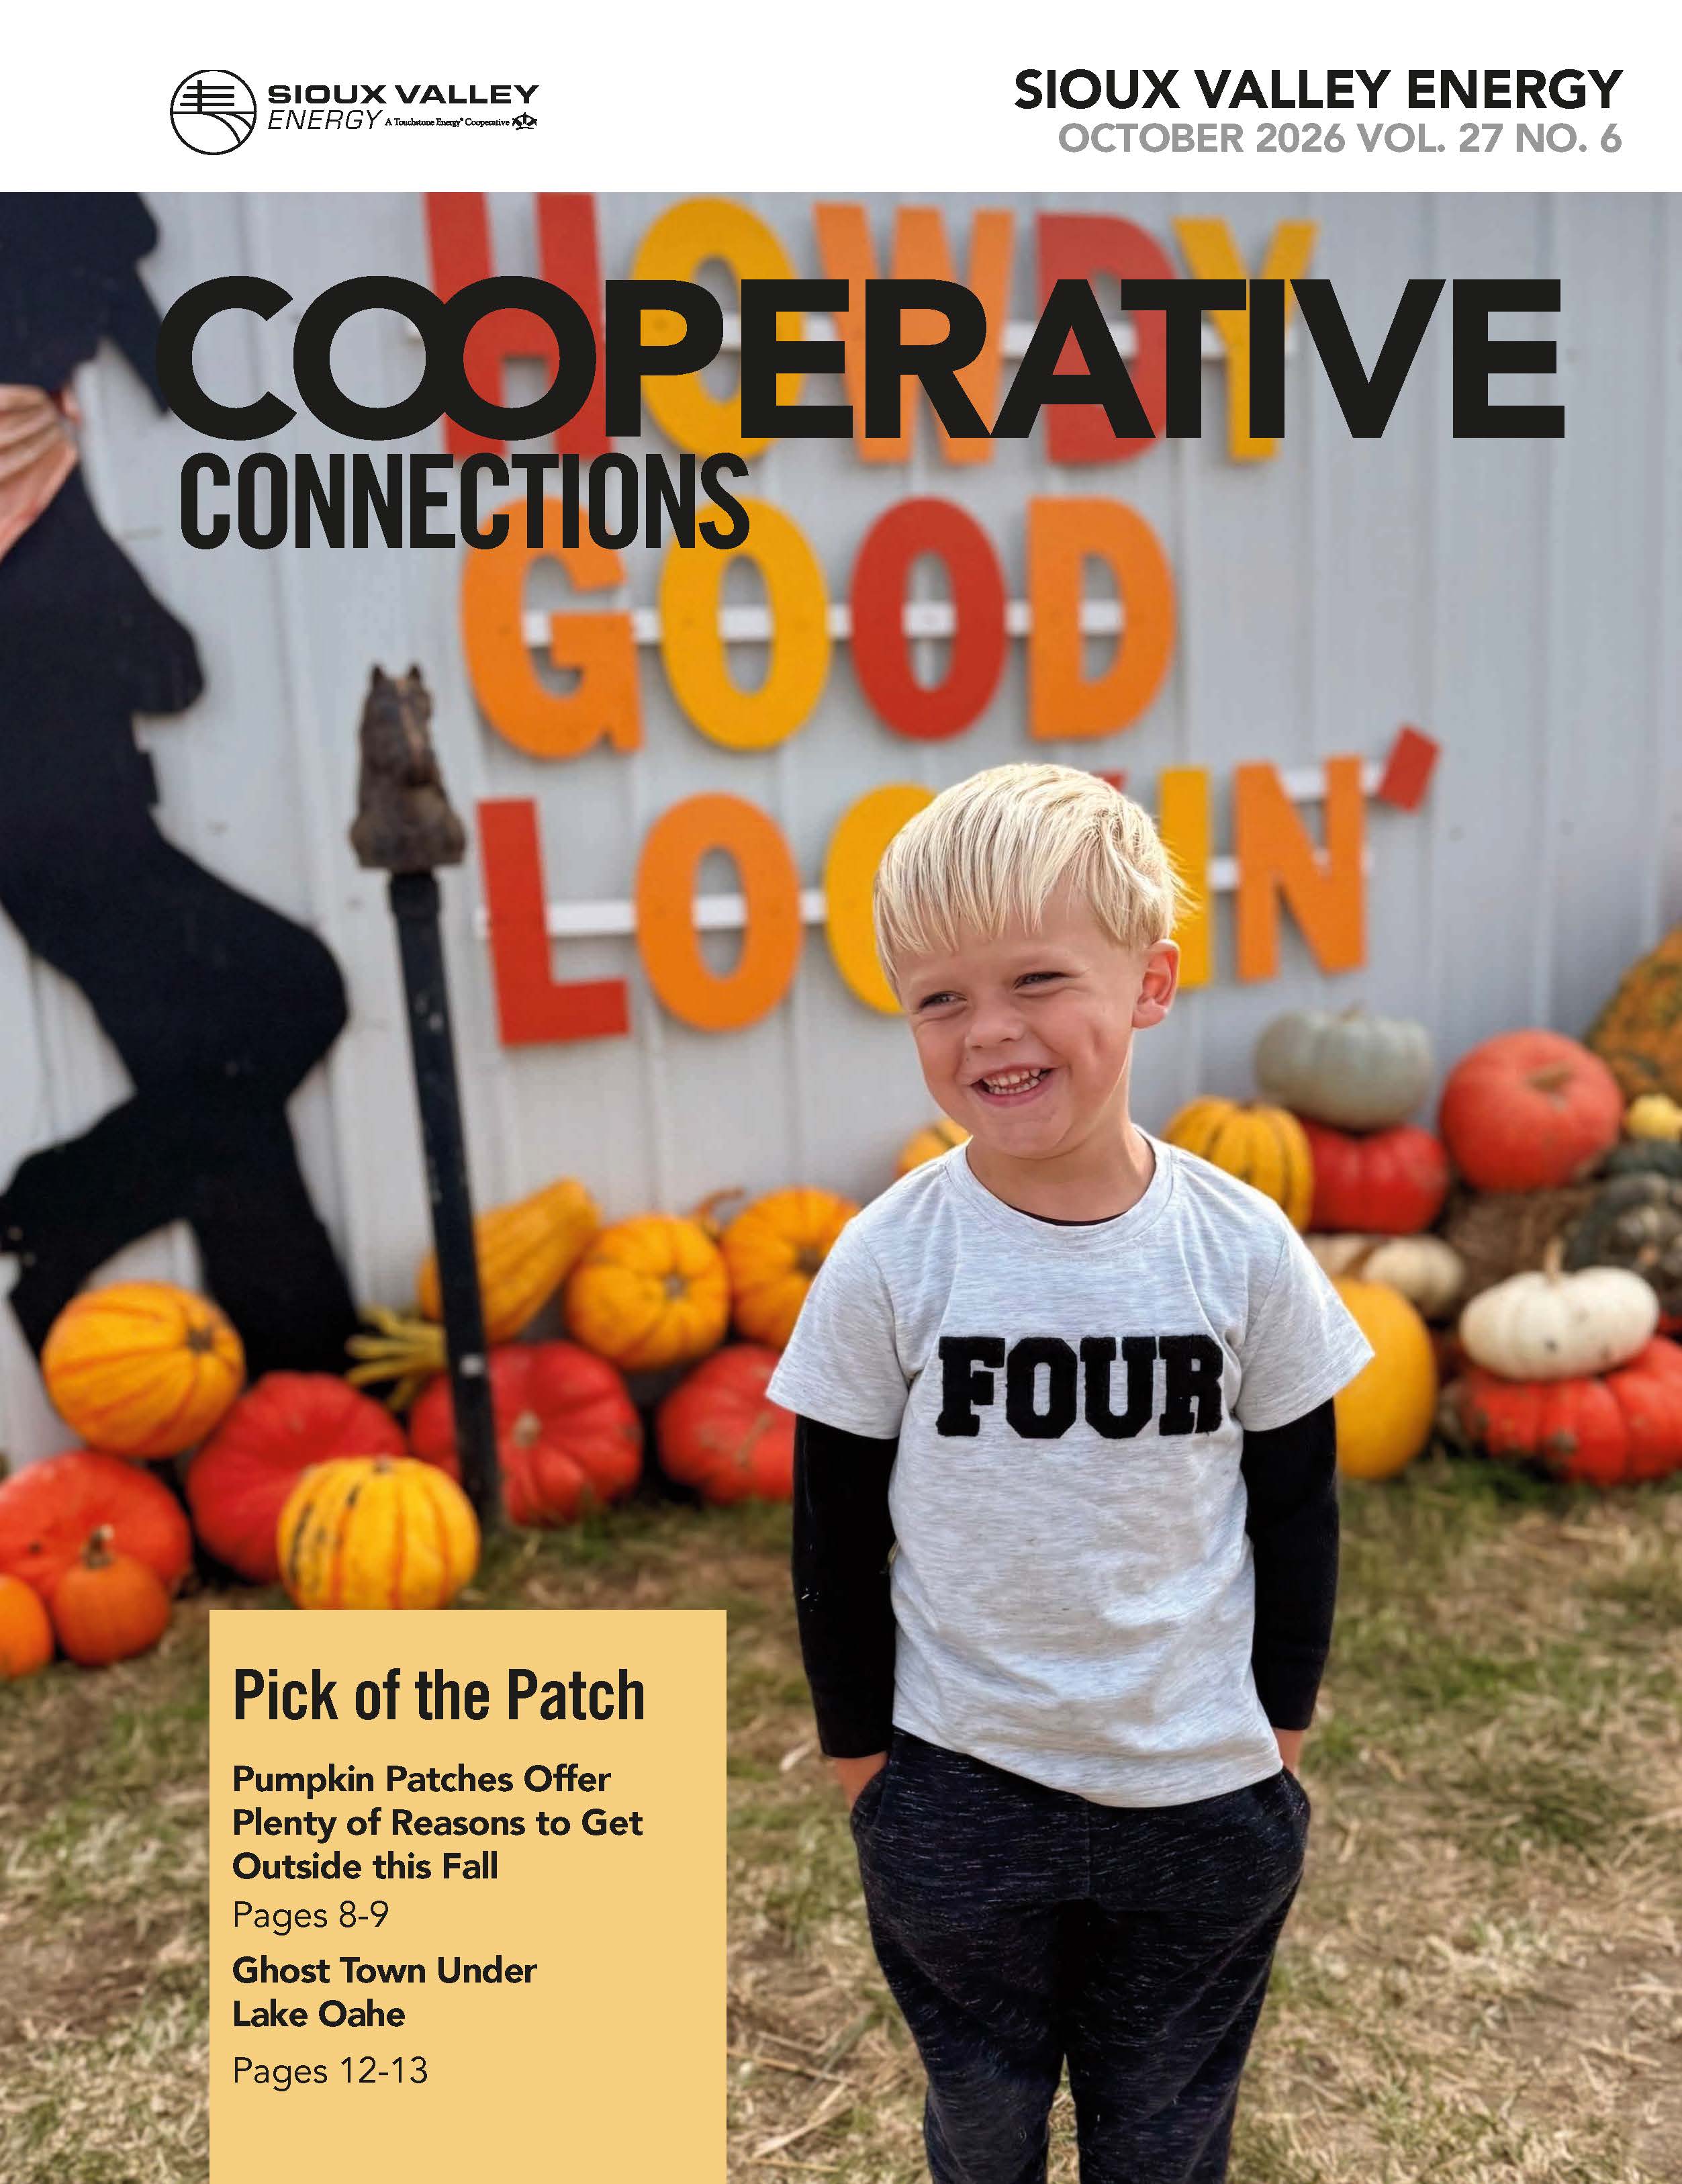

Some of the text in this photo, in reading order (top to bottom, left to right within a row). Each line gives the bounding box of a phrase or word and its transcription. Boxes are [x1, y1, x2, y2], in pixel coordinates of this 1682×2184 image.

[460, 496, 1178, 760] GOOD
[475, 724, 1440, 1048] LOIN'
[936, 1334, 1223, 1439] FOUR
